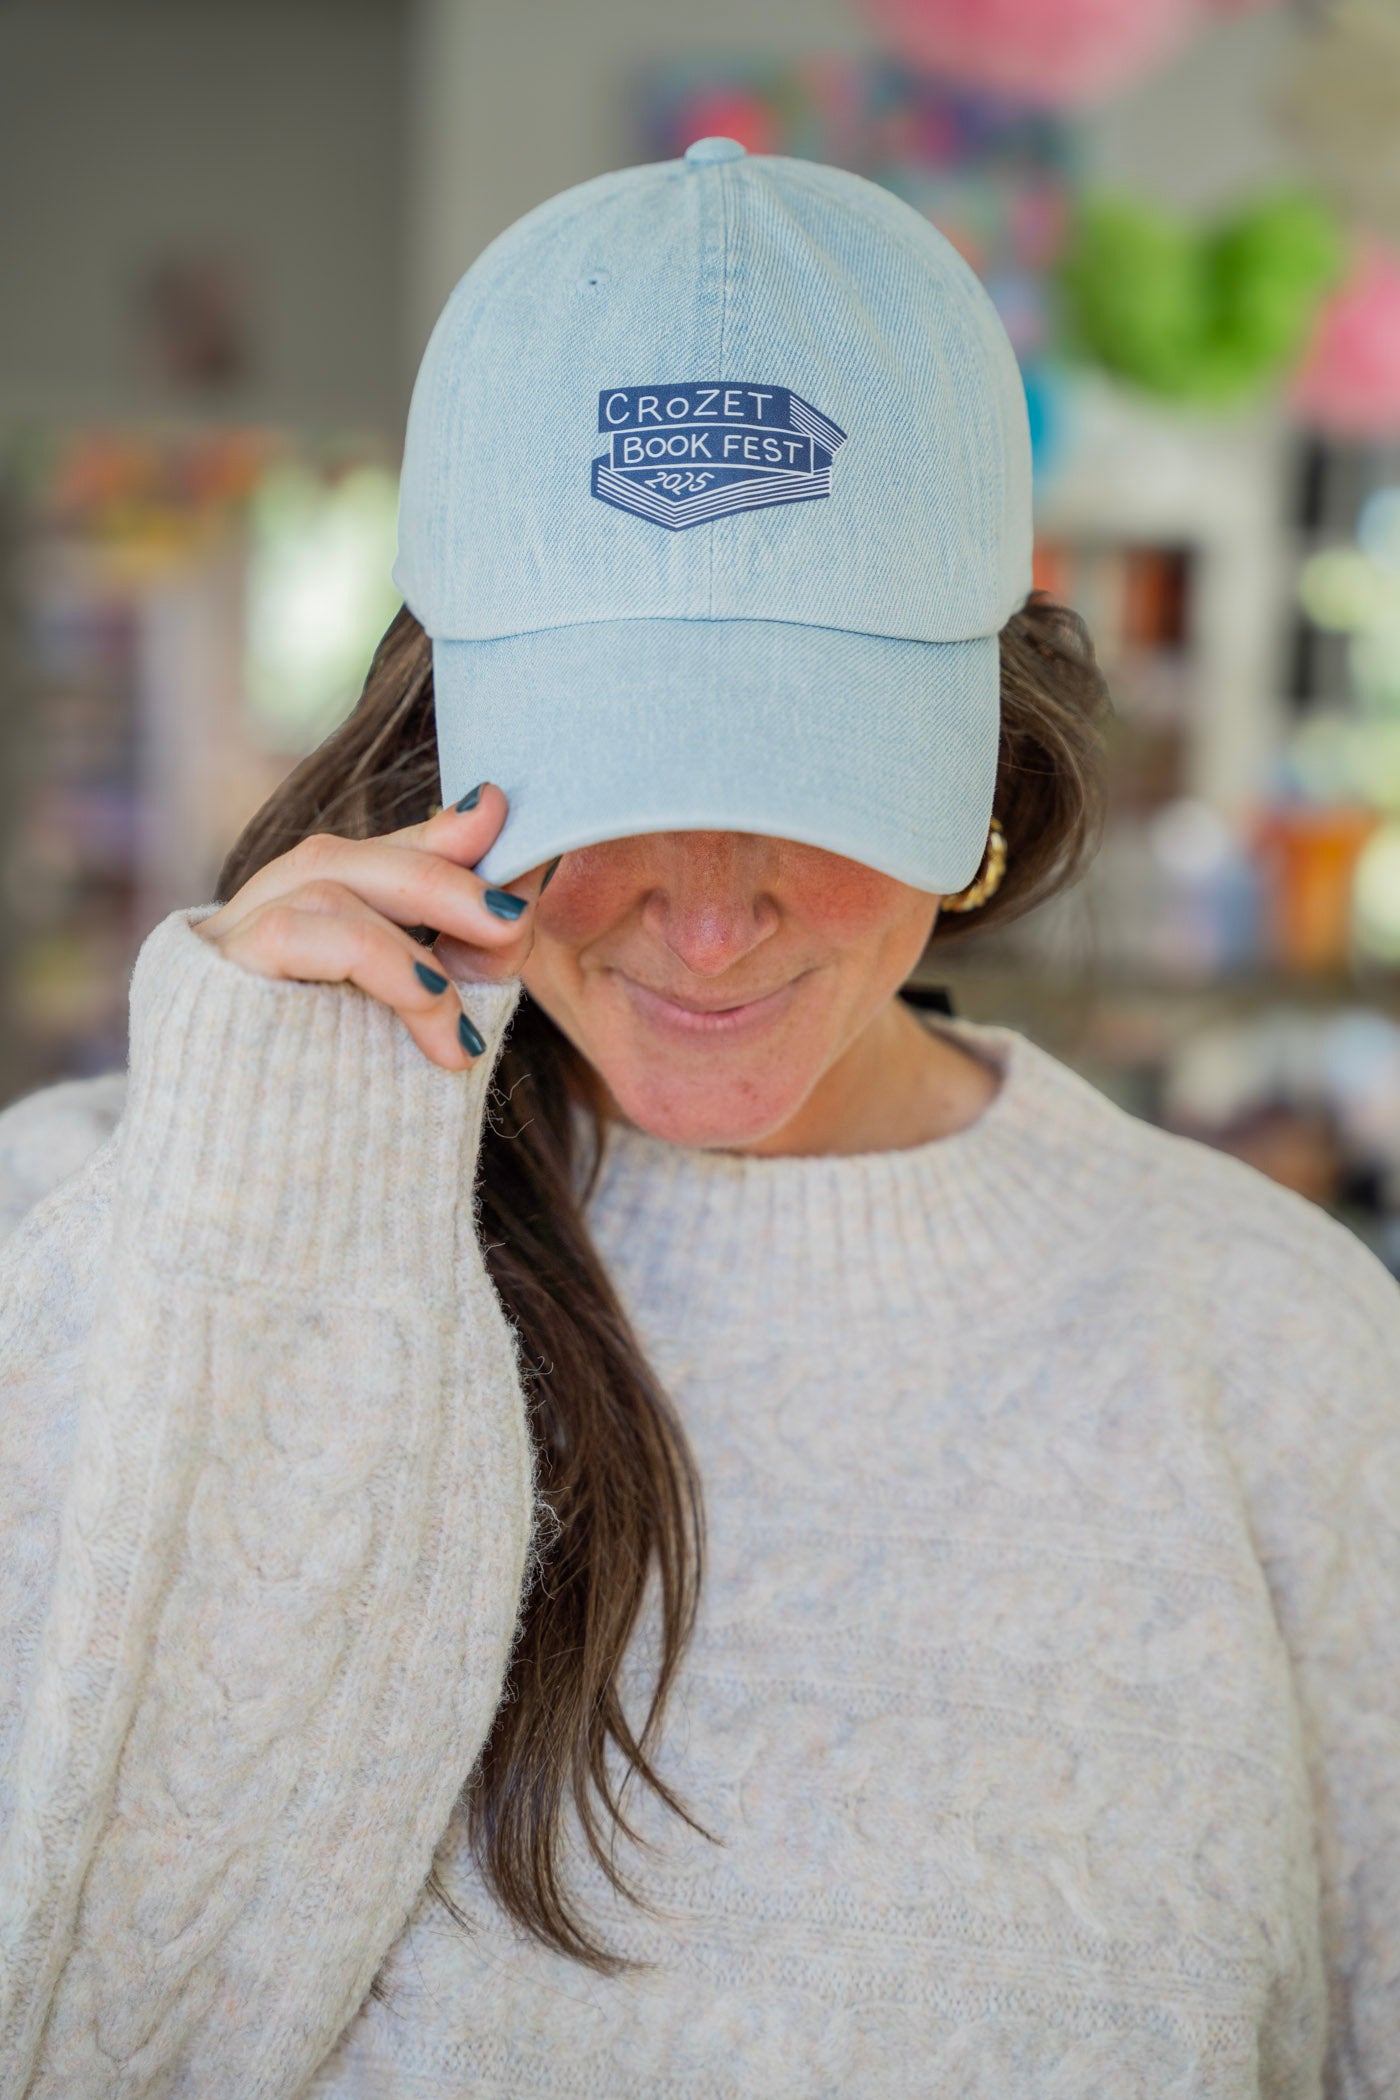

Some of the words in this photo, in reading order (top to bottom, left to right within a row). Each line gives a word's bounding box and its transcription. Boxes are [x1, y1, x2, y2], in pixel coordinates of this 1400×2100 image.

[604, 388, 774, 425] CROZET
[623, 432, 713, 465] BOOK
[723, 434, 804, 464] FEST
[644, 471, 715, 496] 2025
